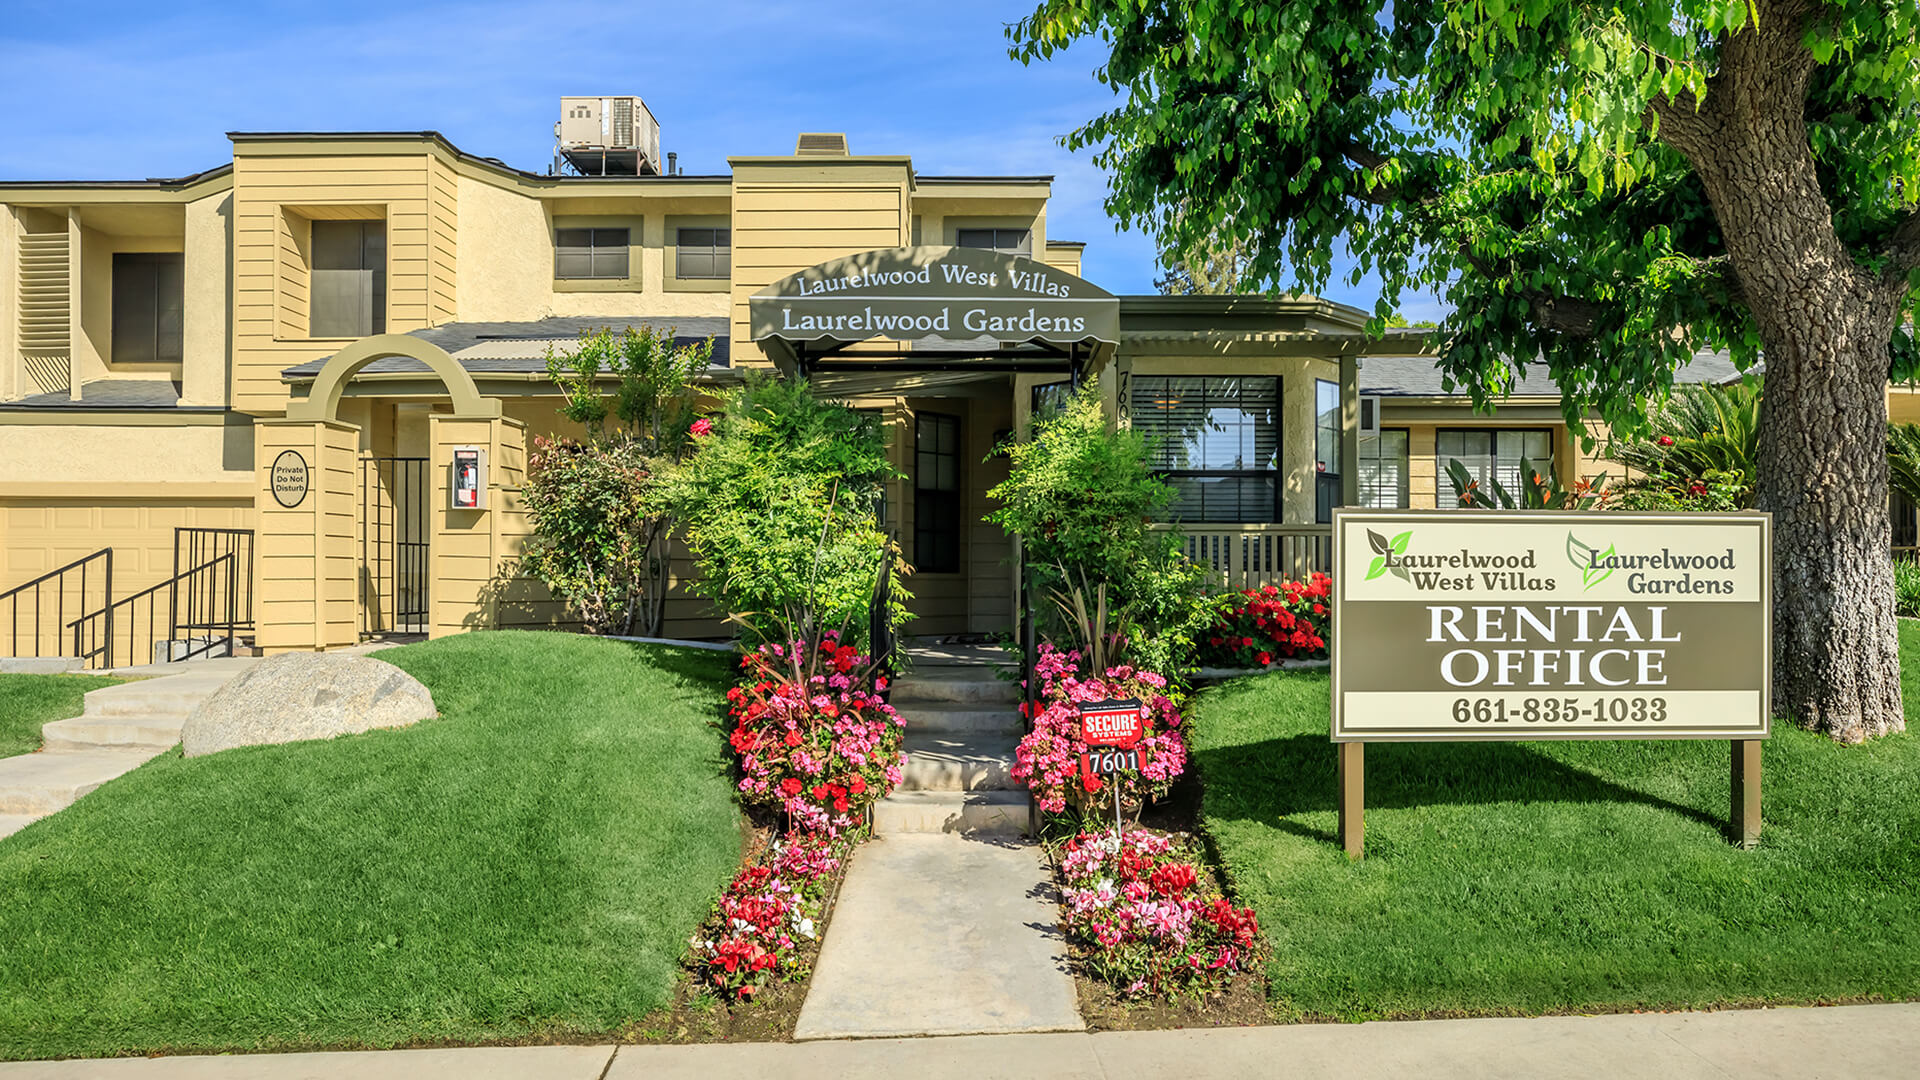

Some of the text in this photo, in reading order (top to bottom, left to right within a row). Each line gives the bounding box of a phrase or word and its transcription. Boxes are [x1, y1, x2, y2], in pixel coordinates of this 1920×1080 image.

[797, 264, 1071, 298] Laurelwood West Villas
[782, 306, 1086, 333] Laurelwood Gardens
[275, 484, 305, 492] Disturb
[1384, 548, 1537, 569] Laurelwood
[1588, 548, 1736, 570] Laurelwood
[1411, 571, 1556, 591] West Villas
[1627, 573, 1734, 595] Gardens
[1425, 606, 1681, 643] RENTAL
[1440, 649, 1668, 687] OFFICE
[1452, 698, 1668, 723] 661-835-1033
[1085, 713, 1137, 732] SECURE
[1089, 751, 1138, 773] 7601
